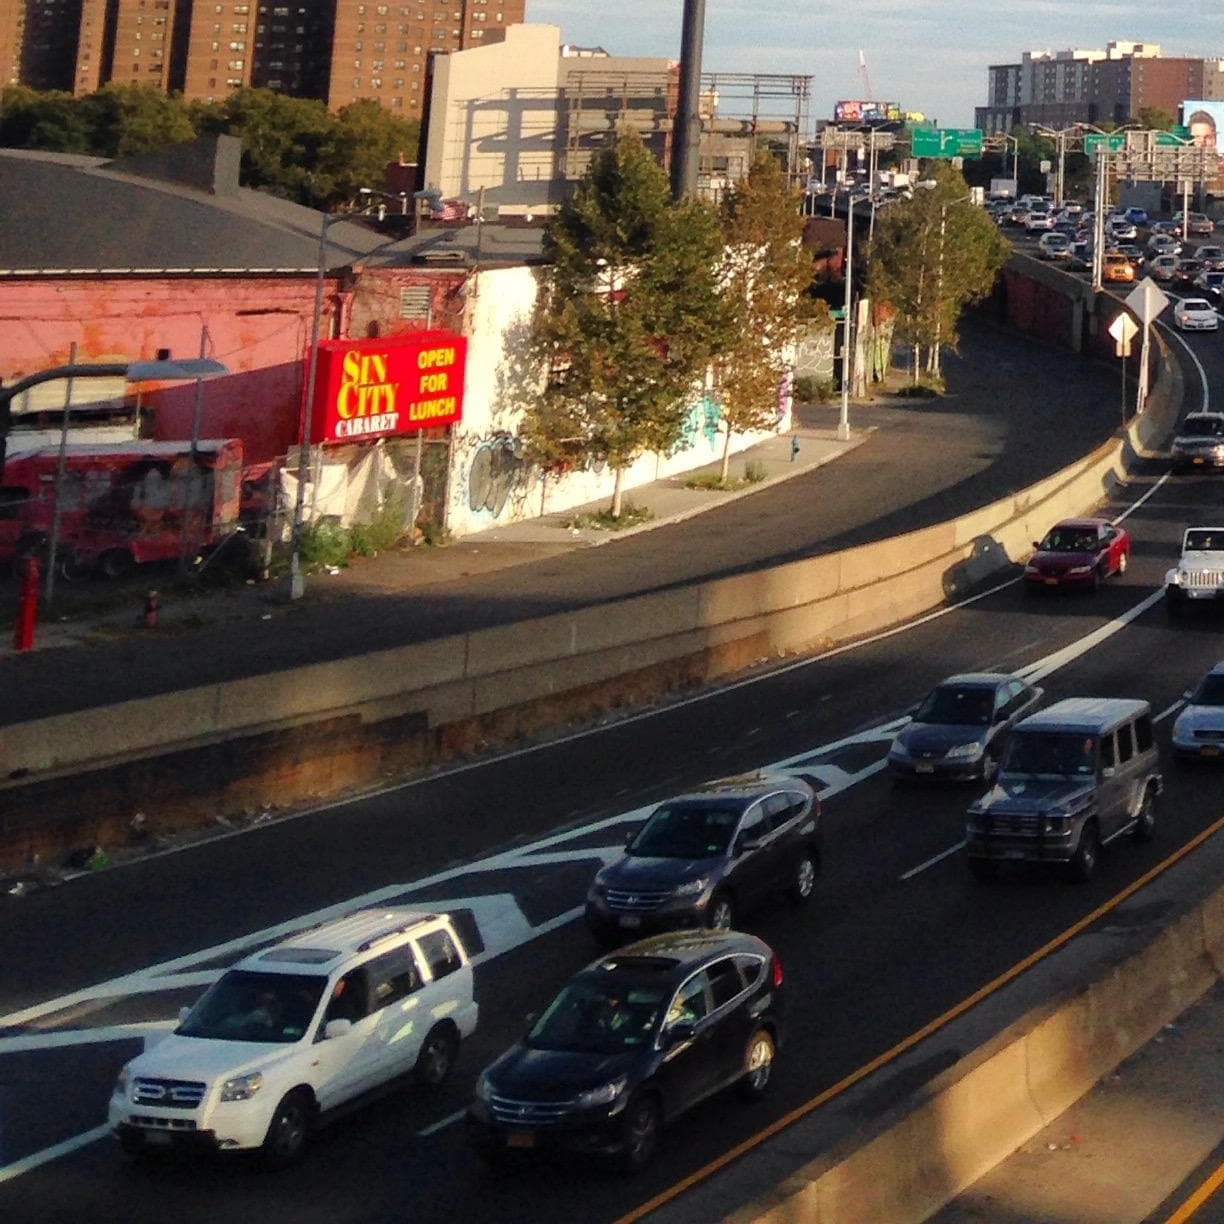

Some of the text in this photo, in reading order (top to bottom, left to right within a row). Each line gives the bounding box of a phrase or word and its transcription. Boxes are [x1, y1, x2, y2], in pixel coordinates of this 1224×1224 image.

[342, 350, 389, 384] SIN
[417, 347, 455, 370] OPEN
[419, 372, 448, 394] FOR
[336, 381, 399, 419] CITY
[408, 396, 456, 422] LUNCH
[334, 412, 400, 438] CABARET
